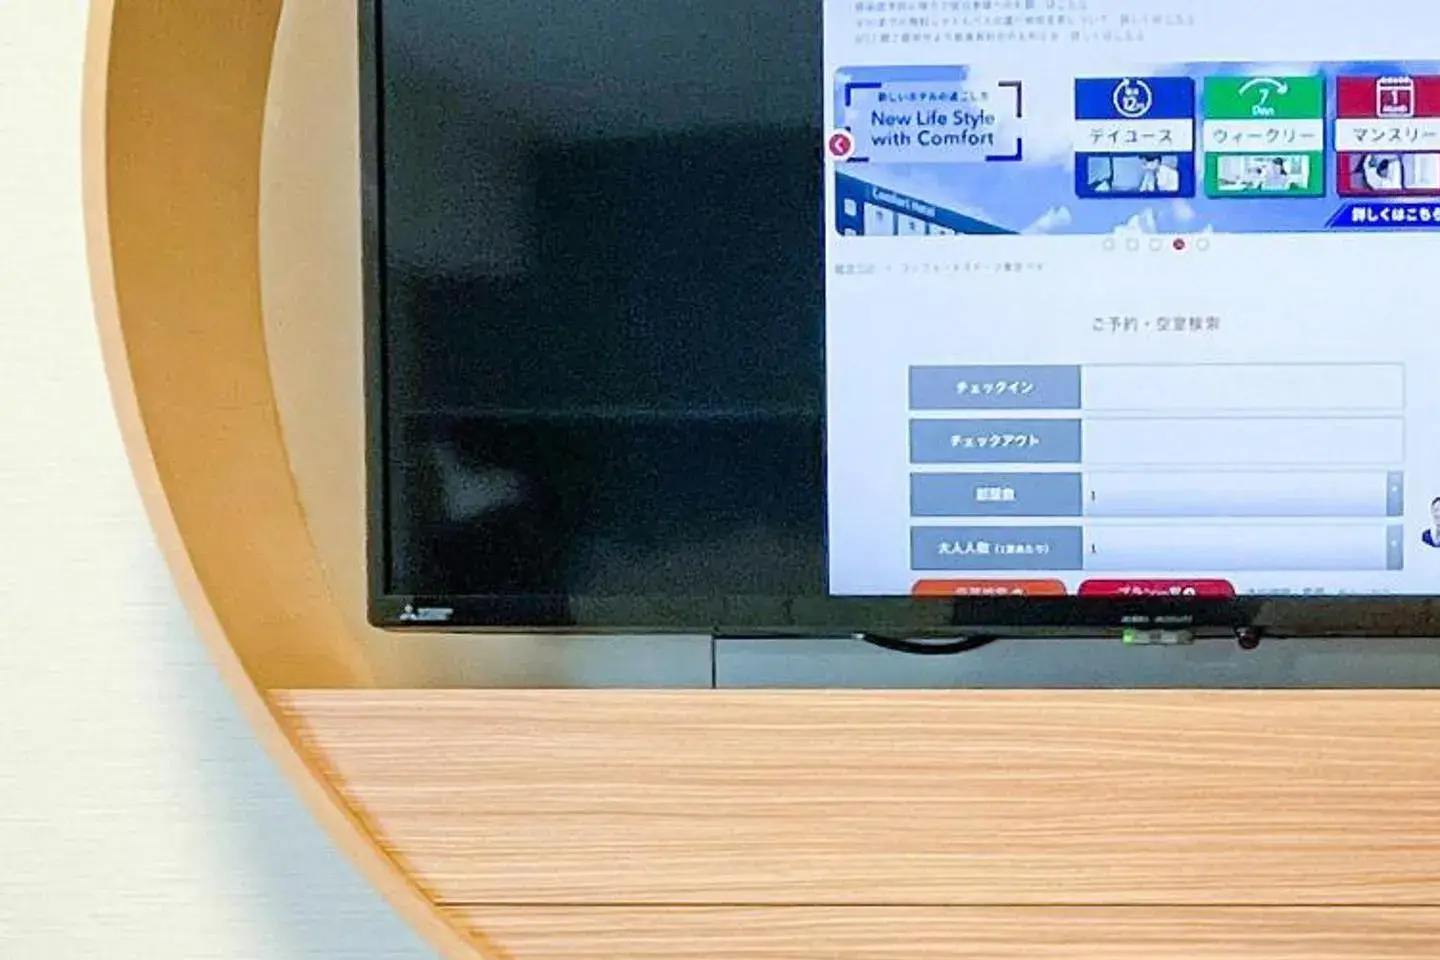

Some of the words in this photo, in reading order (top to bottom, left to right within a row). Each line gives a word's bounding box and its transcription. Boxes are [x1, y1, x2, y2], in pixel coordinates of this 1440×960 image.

[871, 111, 911, 126] New
[917, 111, 947, 126] Life
[953, 109, 995, 130] Style
[872, 131, 911, 146] with
[917, 129, 994, 147] Comfort
[1212, 127, 1315, 144] ウィークリー
[1354, 127, 1437, 143] マンスリー
[1092, 316, 1221, 332] ご予約・空室検索
[956, 381, 1034, 395] チェックイン
[951, 434, 1040, 448] チェックアウト
